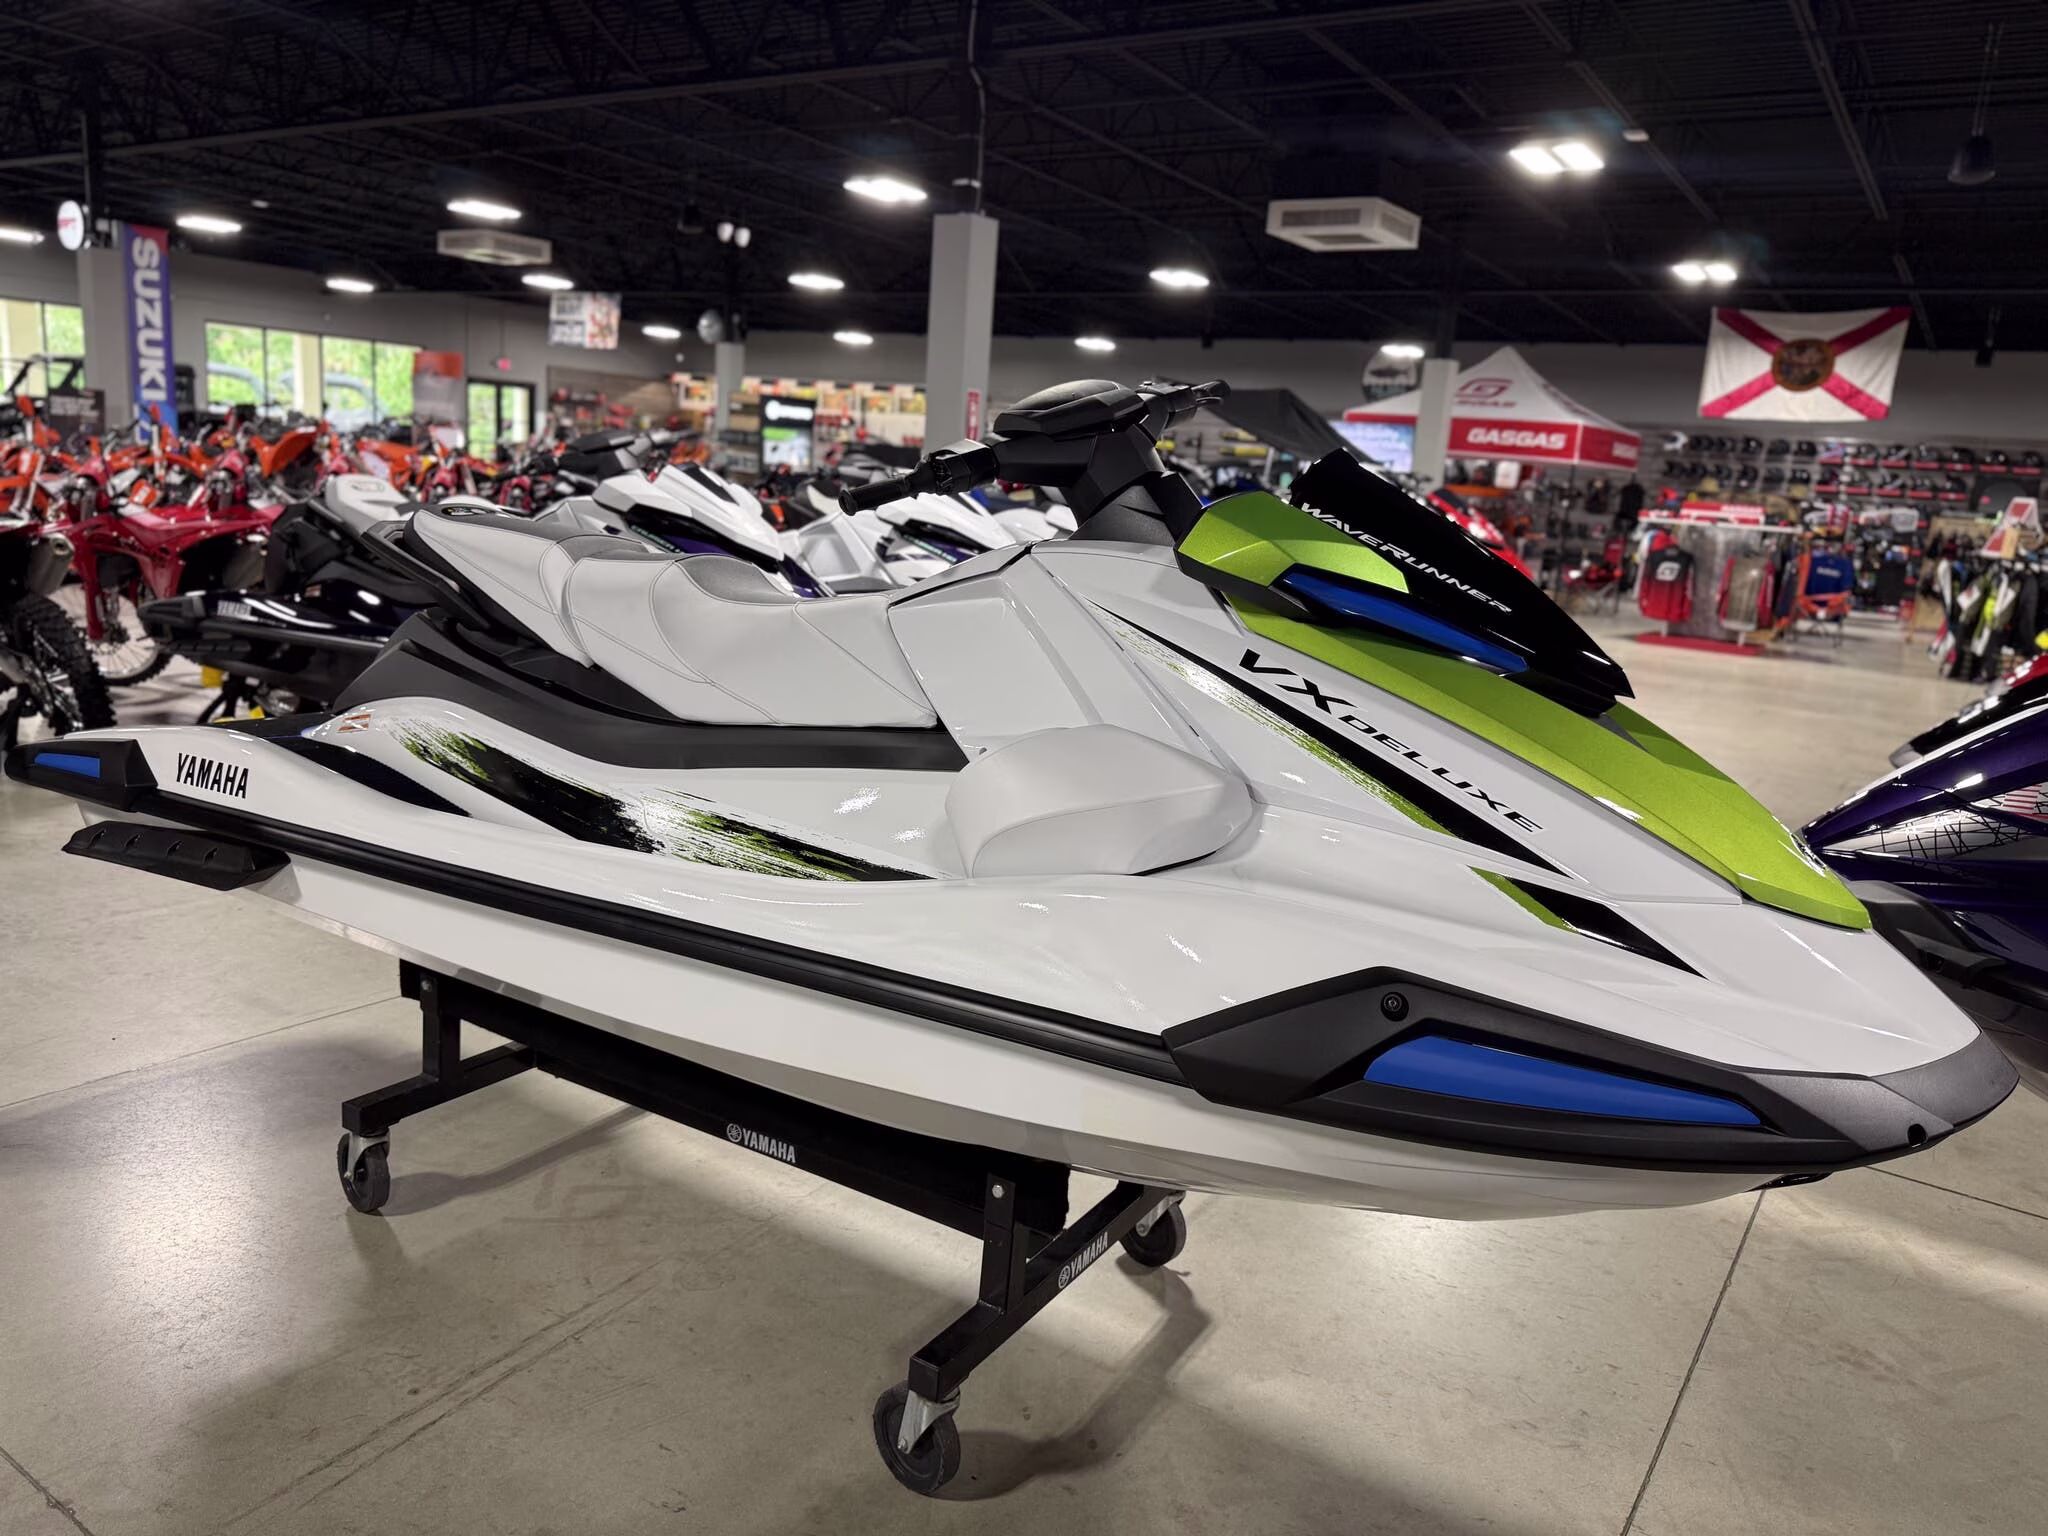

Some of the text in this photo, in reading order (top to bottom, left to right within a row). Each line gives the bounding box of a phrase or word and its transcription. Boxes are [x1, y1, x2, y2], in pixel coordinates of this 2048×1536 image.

[132, 236, 168, 402] SUZUKI
[1466, 427, 1569, 450] GASGAS
[1301, 502, 1513, 615] WAVERUNNER
[1239, 648, 1544, 833] VX DELUXE
[176, 752, 249, 799] YAMAHA
[742, 1127, 796, 1164] YAMAHA
[1070, 1231, 1108, 1279] YAMAHA
